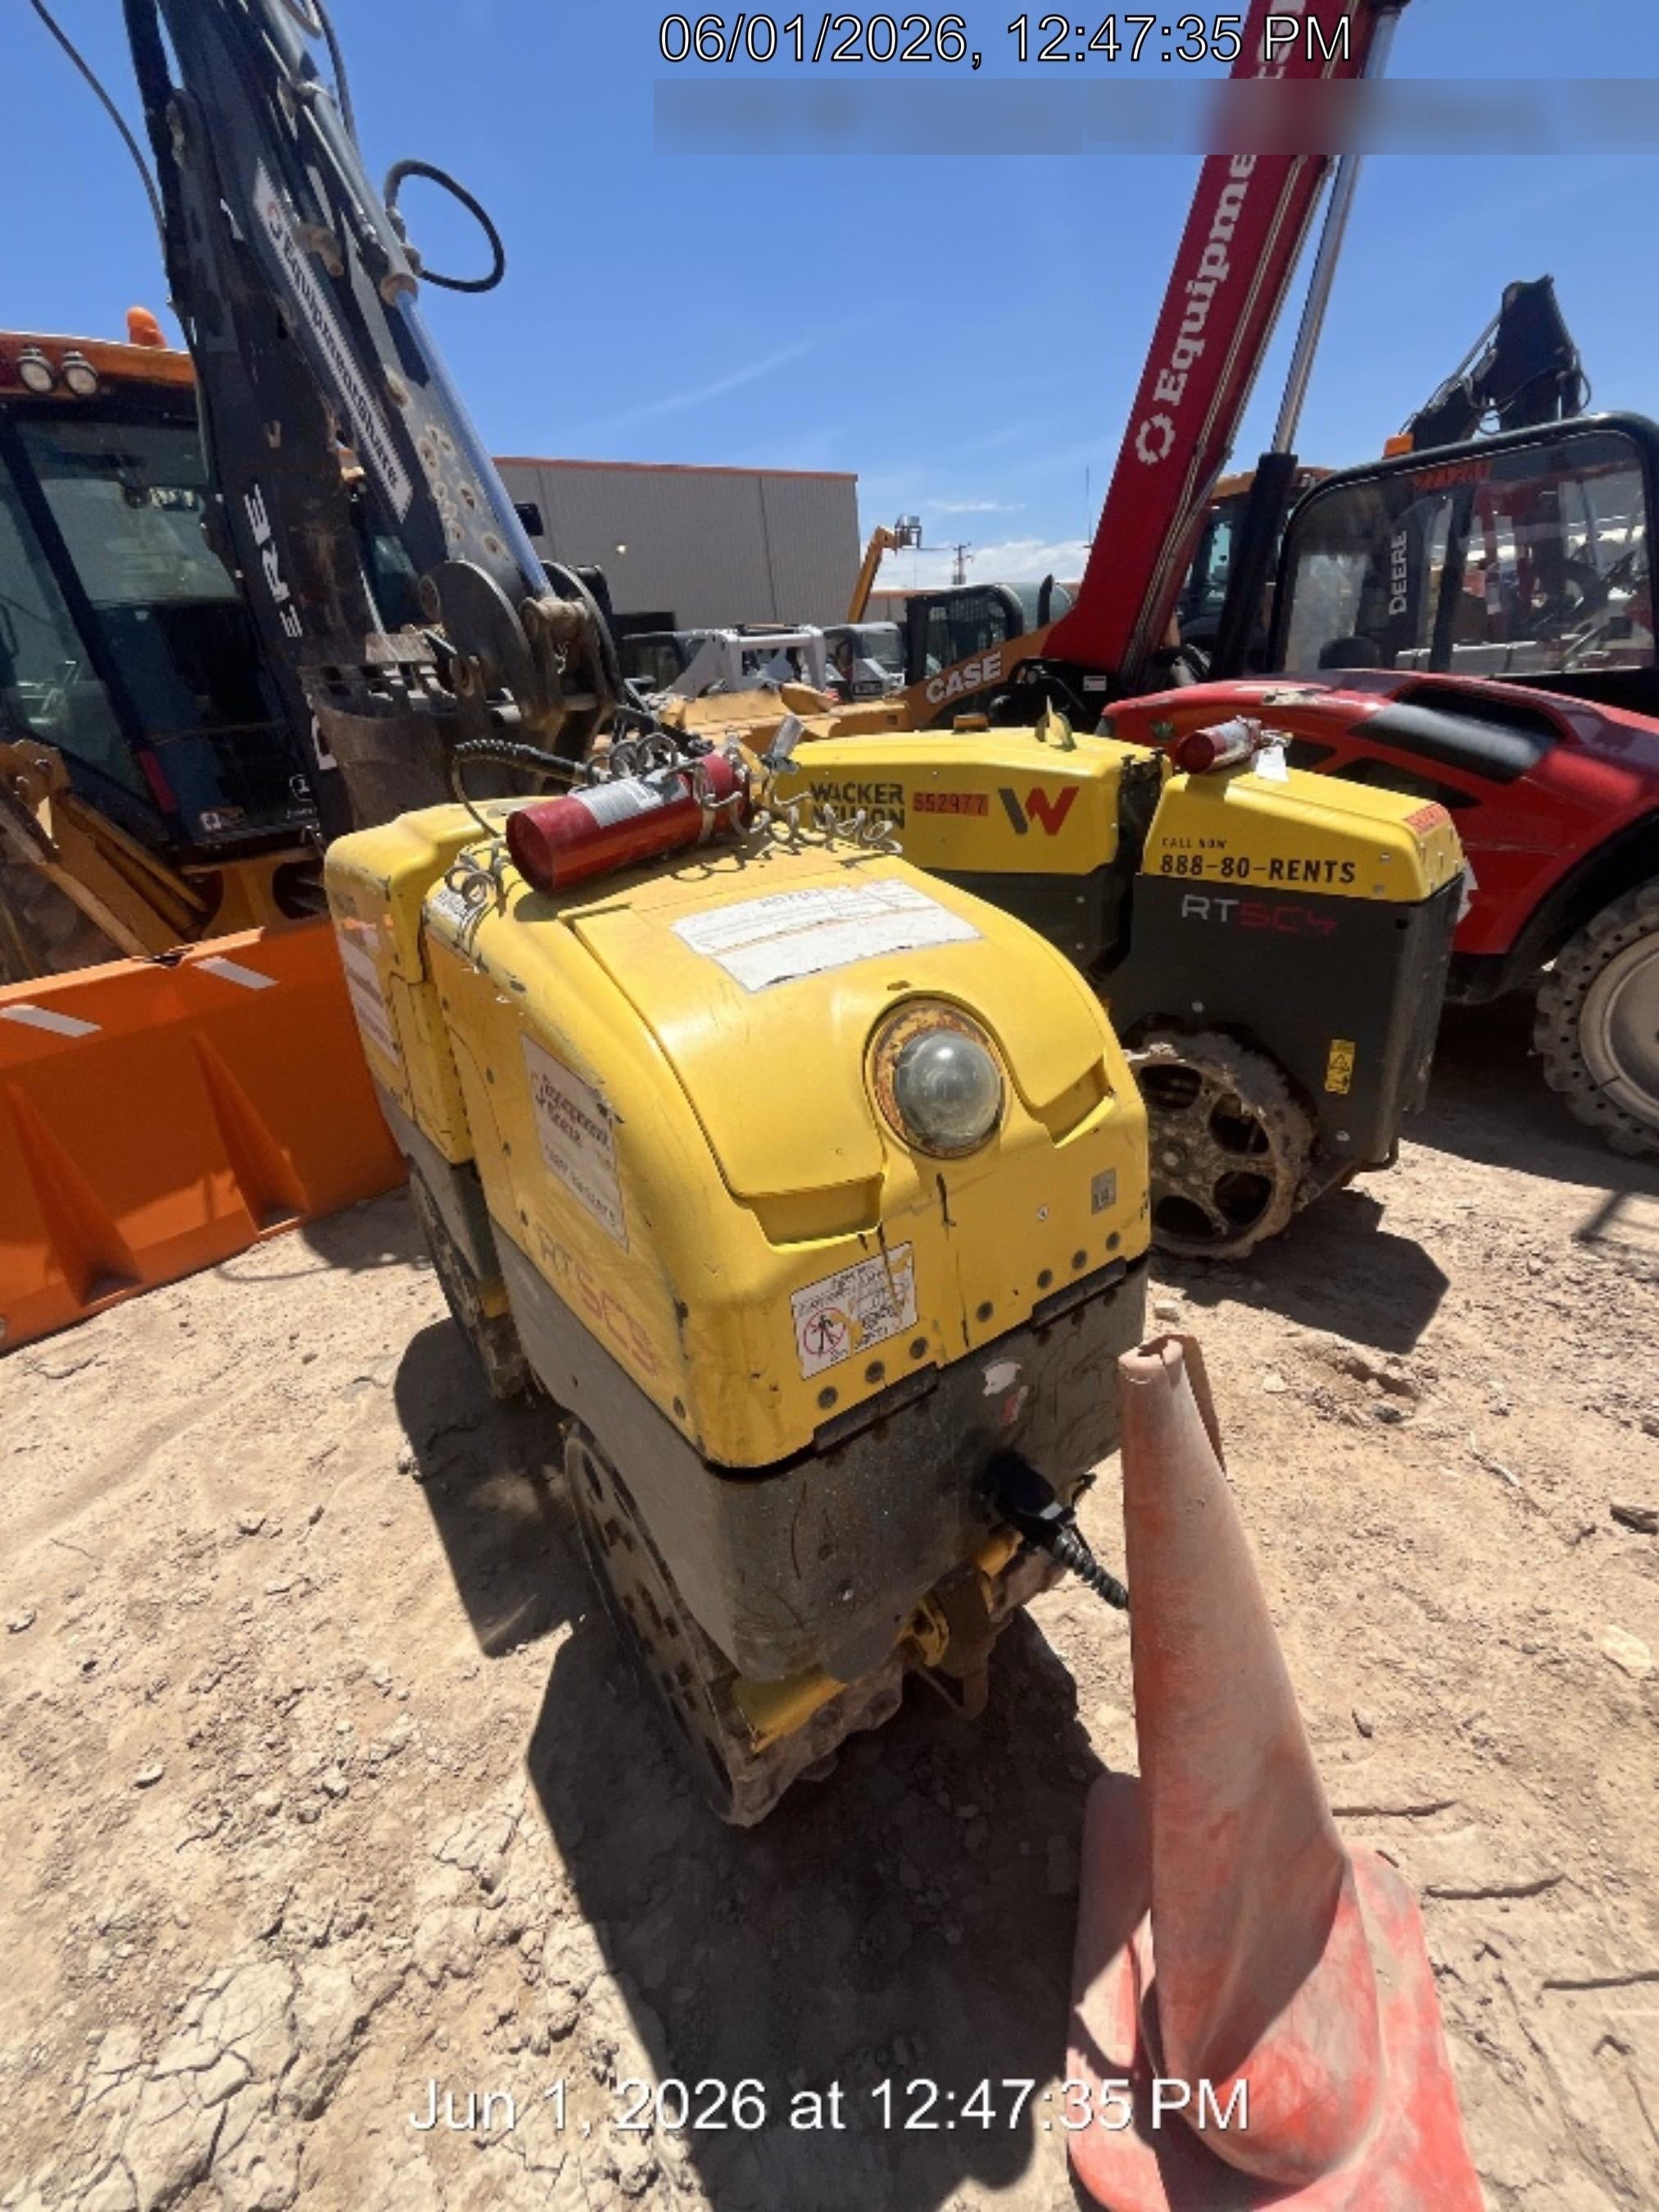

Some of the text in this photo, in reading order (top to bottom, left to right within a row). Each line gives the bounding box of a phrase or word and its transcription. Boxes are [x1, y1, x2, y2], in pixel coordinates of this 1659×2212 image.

[1389, 530, 1407, 616] DEERE
[926, 650, 1001, 704] CASE
[809, 782, 905, 804] WACKER
[1160, 854, 1356, 883] 888-80-RENTS
